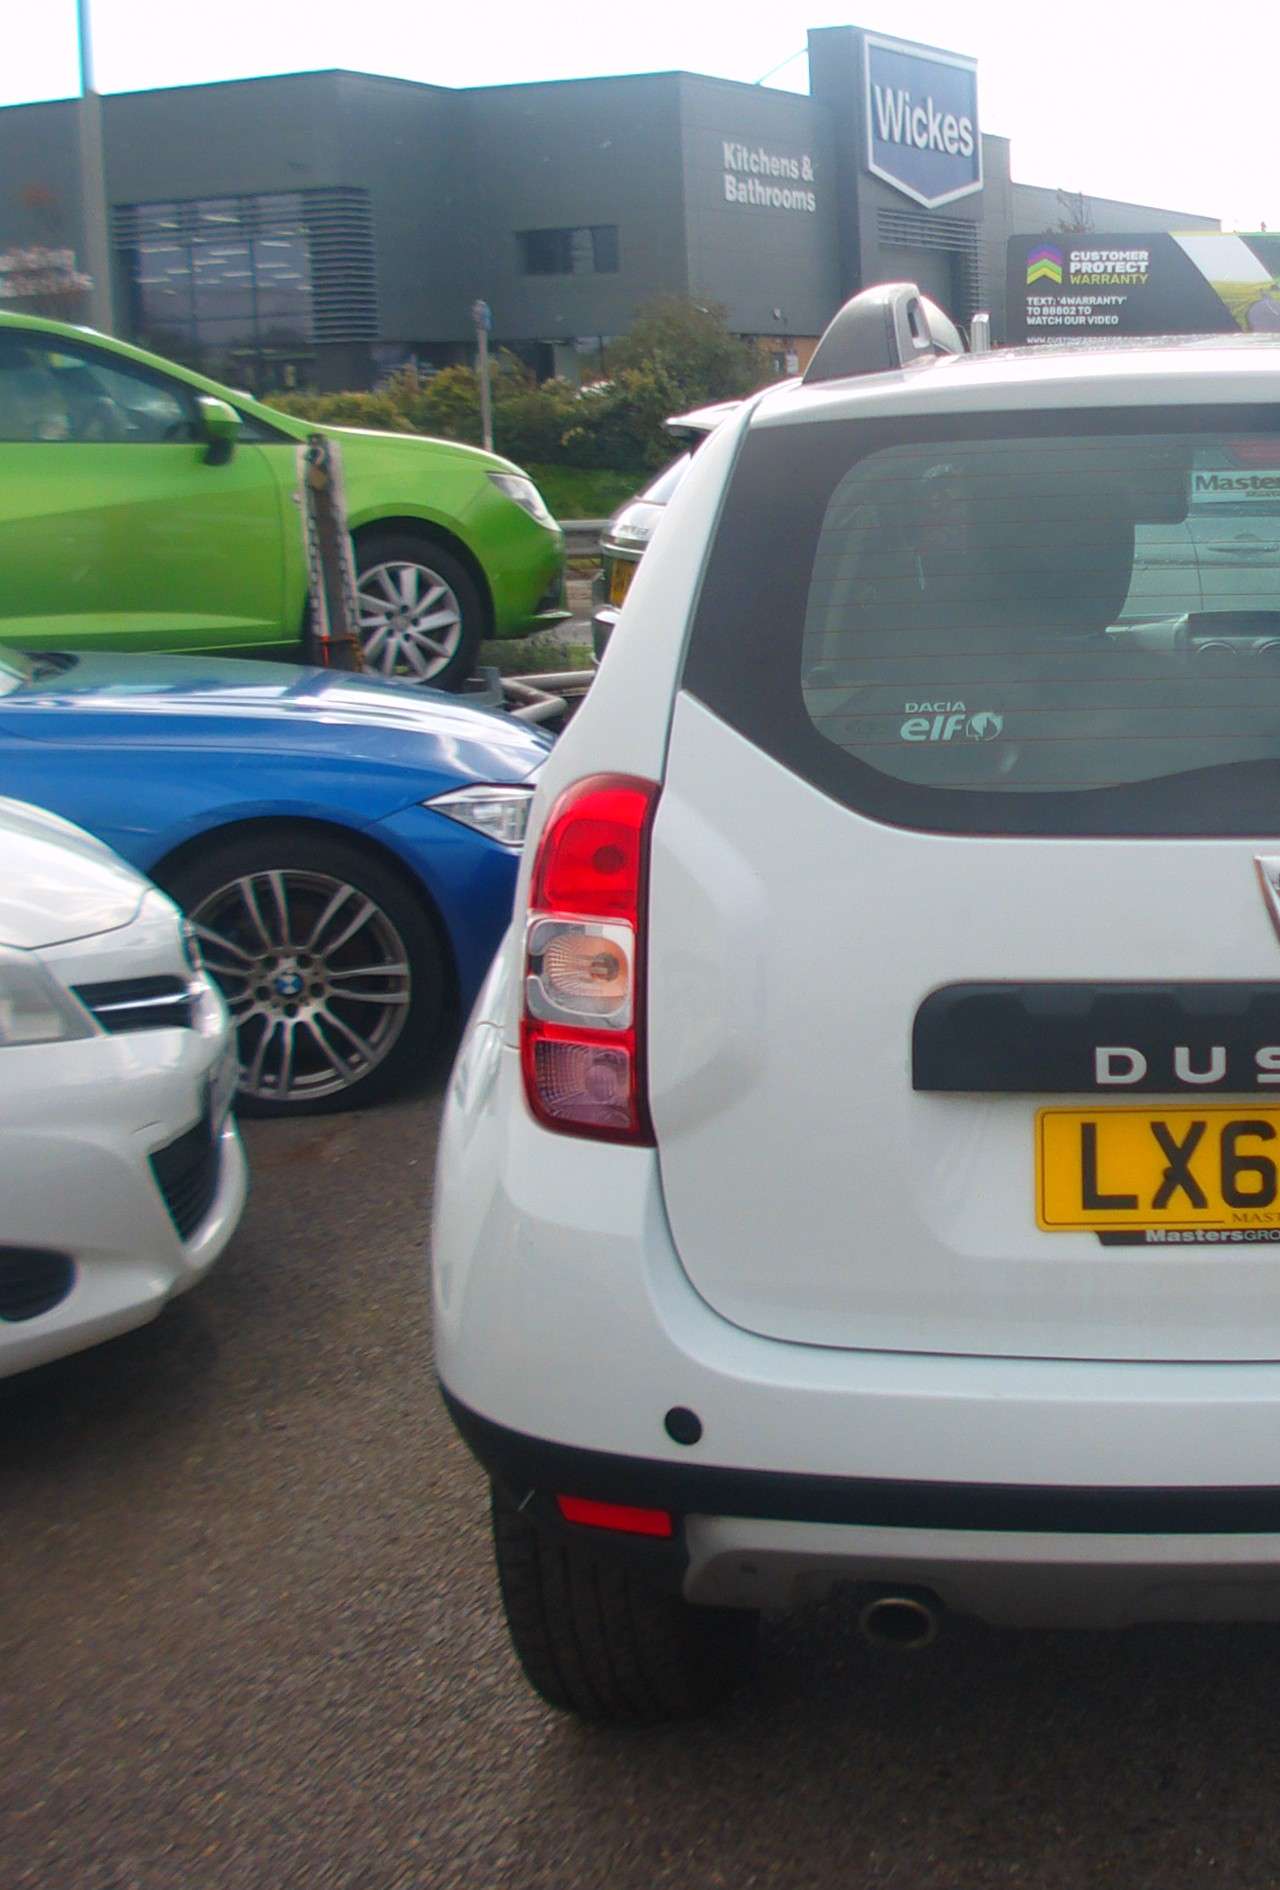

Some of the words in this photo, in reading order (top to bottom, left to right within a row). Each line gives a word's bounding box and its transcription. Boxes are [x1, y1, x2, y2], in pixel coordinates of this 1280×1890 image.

[875, 84, 973, 157] Wickes
[722, 142, 799, 177] Kitchens
[800, 155, 814, 182] &
[724, 174, 816, 212] Bathrooms
[1069, 251, 1149, 261] CUSTOMER
[1069, 262, 1149, 273] PROTECT
[1069, 274, 1149, 285] WARRANTY
[1026, 307, 1040, 315] TO
[1026, 316, 1062, 325] WATCH
[1063, 316, 1086, 325] OUR
[1087, 316, 1119, 325] VIDEO
[904, 702, 966, 713] DACIA
[900, 714, 966, 741] elf
